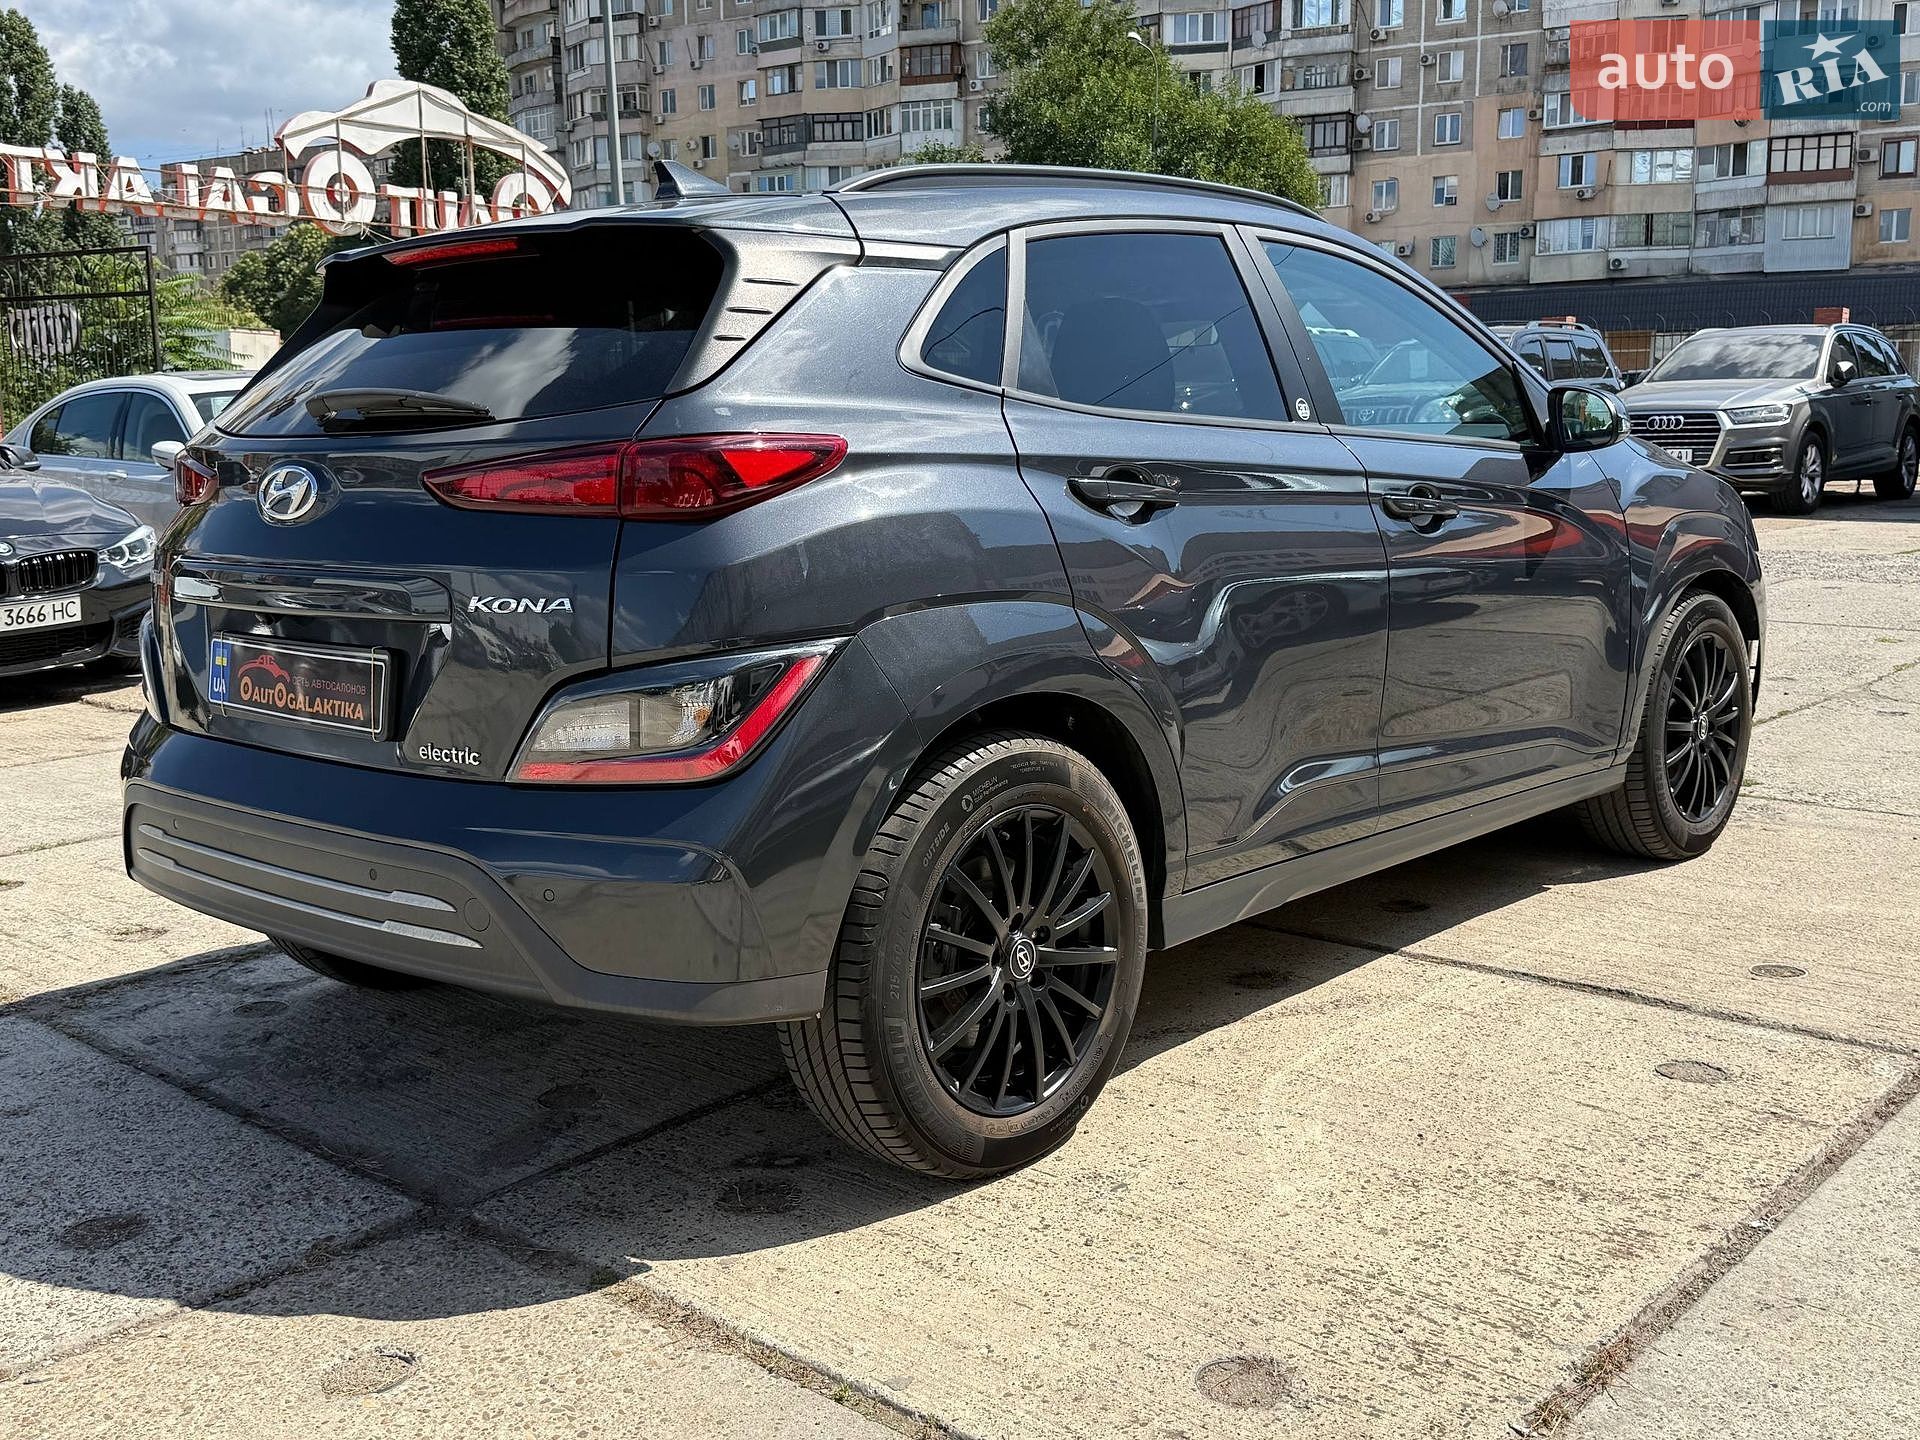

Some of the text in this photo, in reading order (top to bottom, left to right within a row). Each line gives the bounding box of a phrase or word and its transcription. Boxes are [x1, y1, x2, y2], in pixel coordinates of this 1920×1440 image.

[4, 601, 77, 626] 3666 HC
[467, 596, 574, 614] KONA
[213, 677, 226, 693] UA
[311, 679, 366, 695] АВТОСАЛОНОВ
[419, 744, 482, 766] electric
[972, 776, 998, 798] MICHELIN
[922, 821, 950, 868] OUTSIDE
[1100, 794, 1145, 904] MICHELIN
